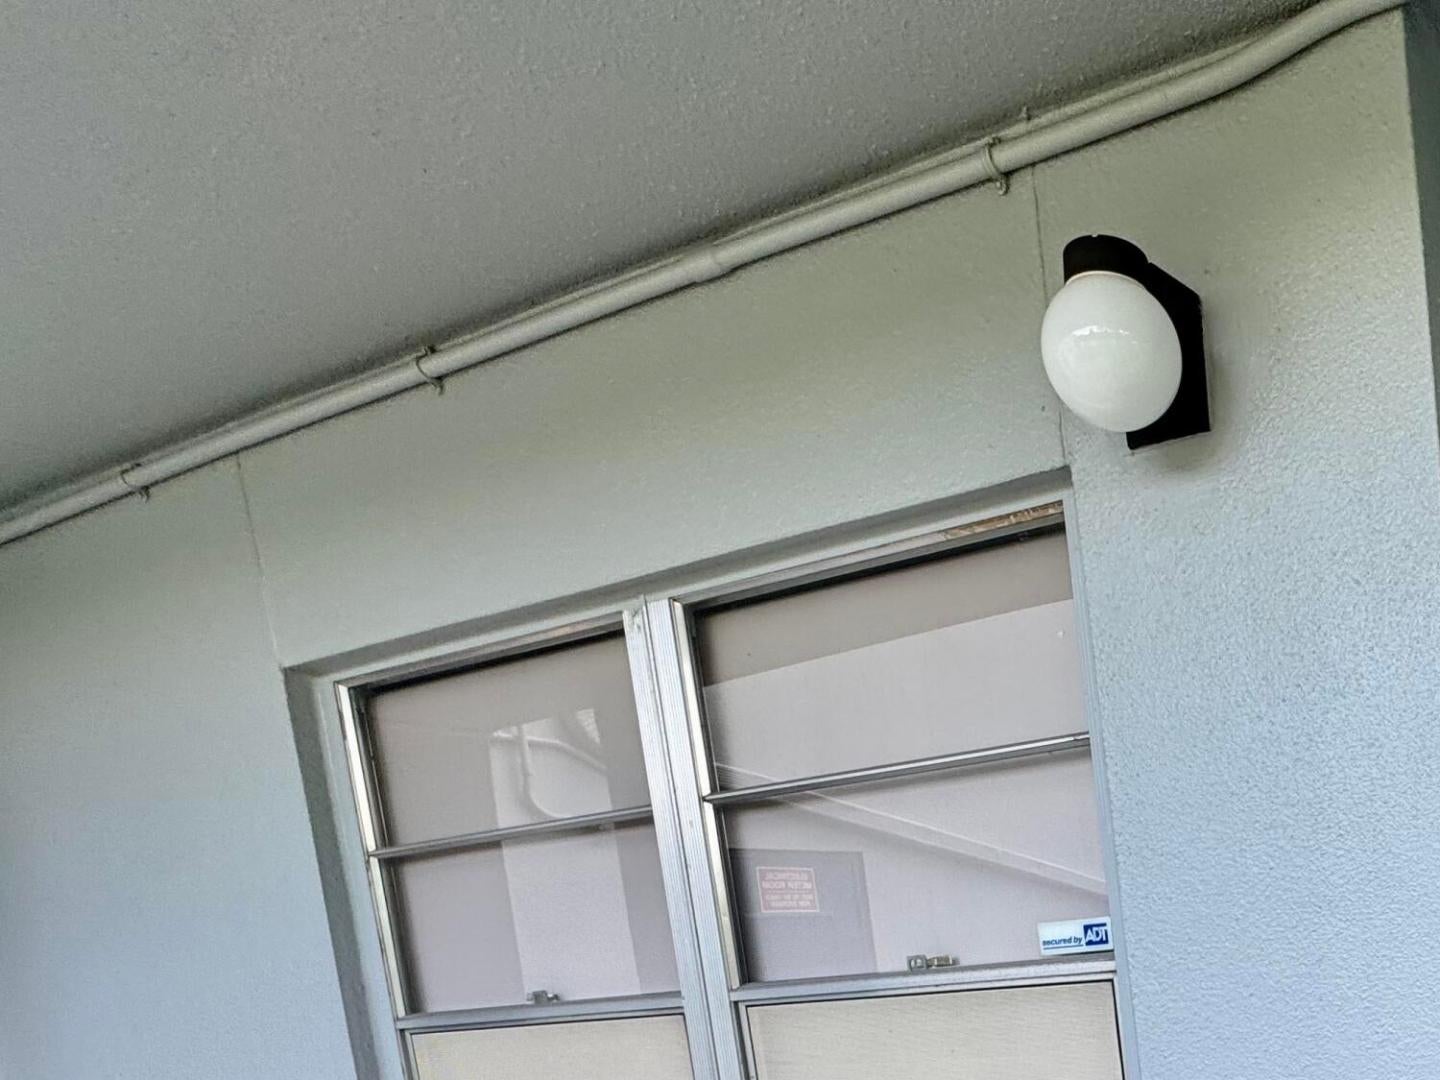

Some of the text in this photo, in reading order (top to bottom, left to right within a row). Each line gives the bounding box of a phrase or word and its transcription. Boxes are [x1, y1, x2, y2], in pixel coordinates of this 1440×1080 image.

[1042, 926, 1107, 946] secured by ADT
